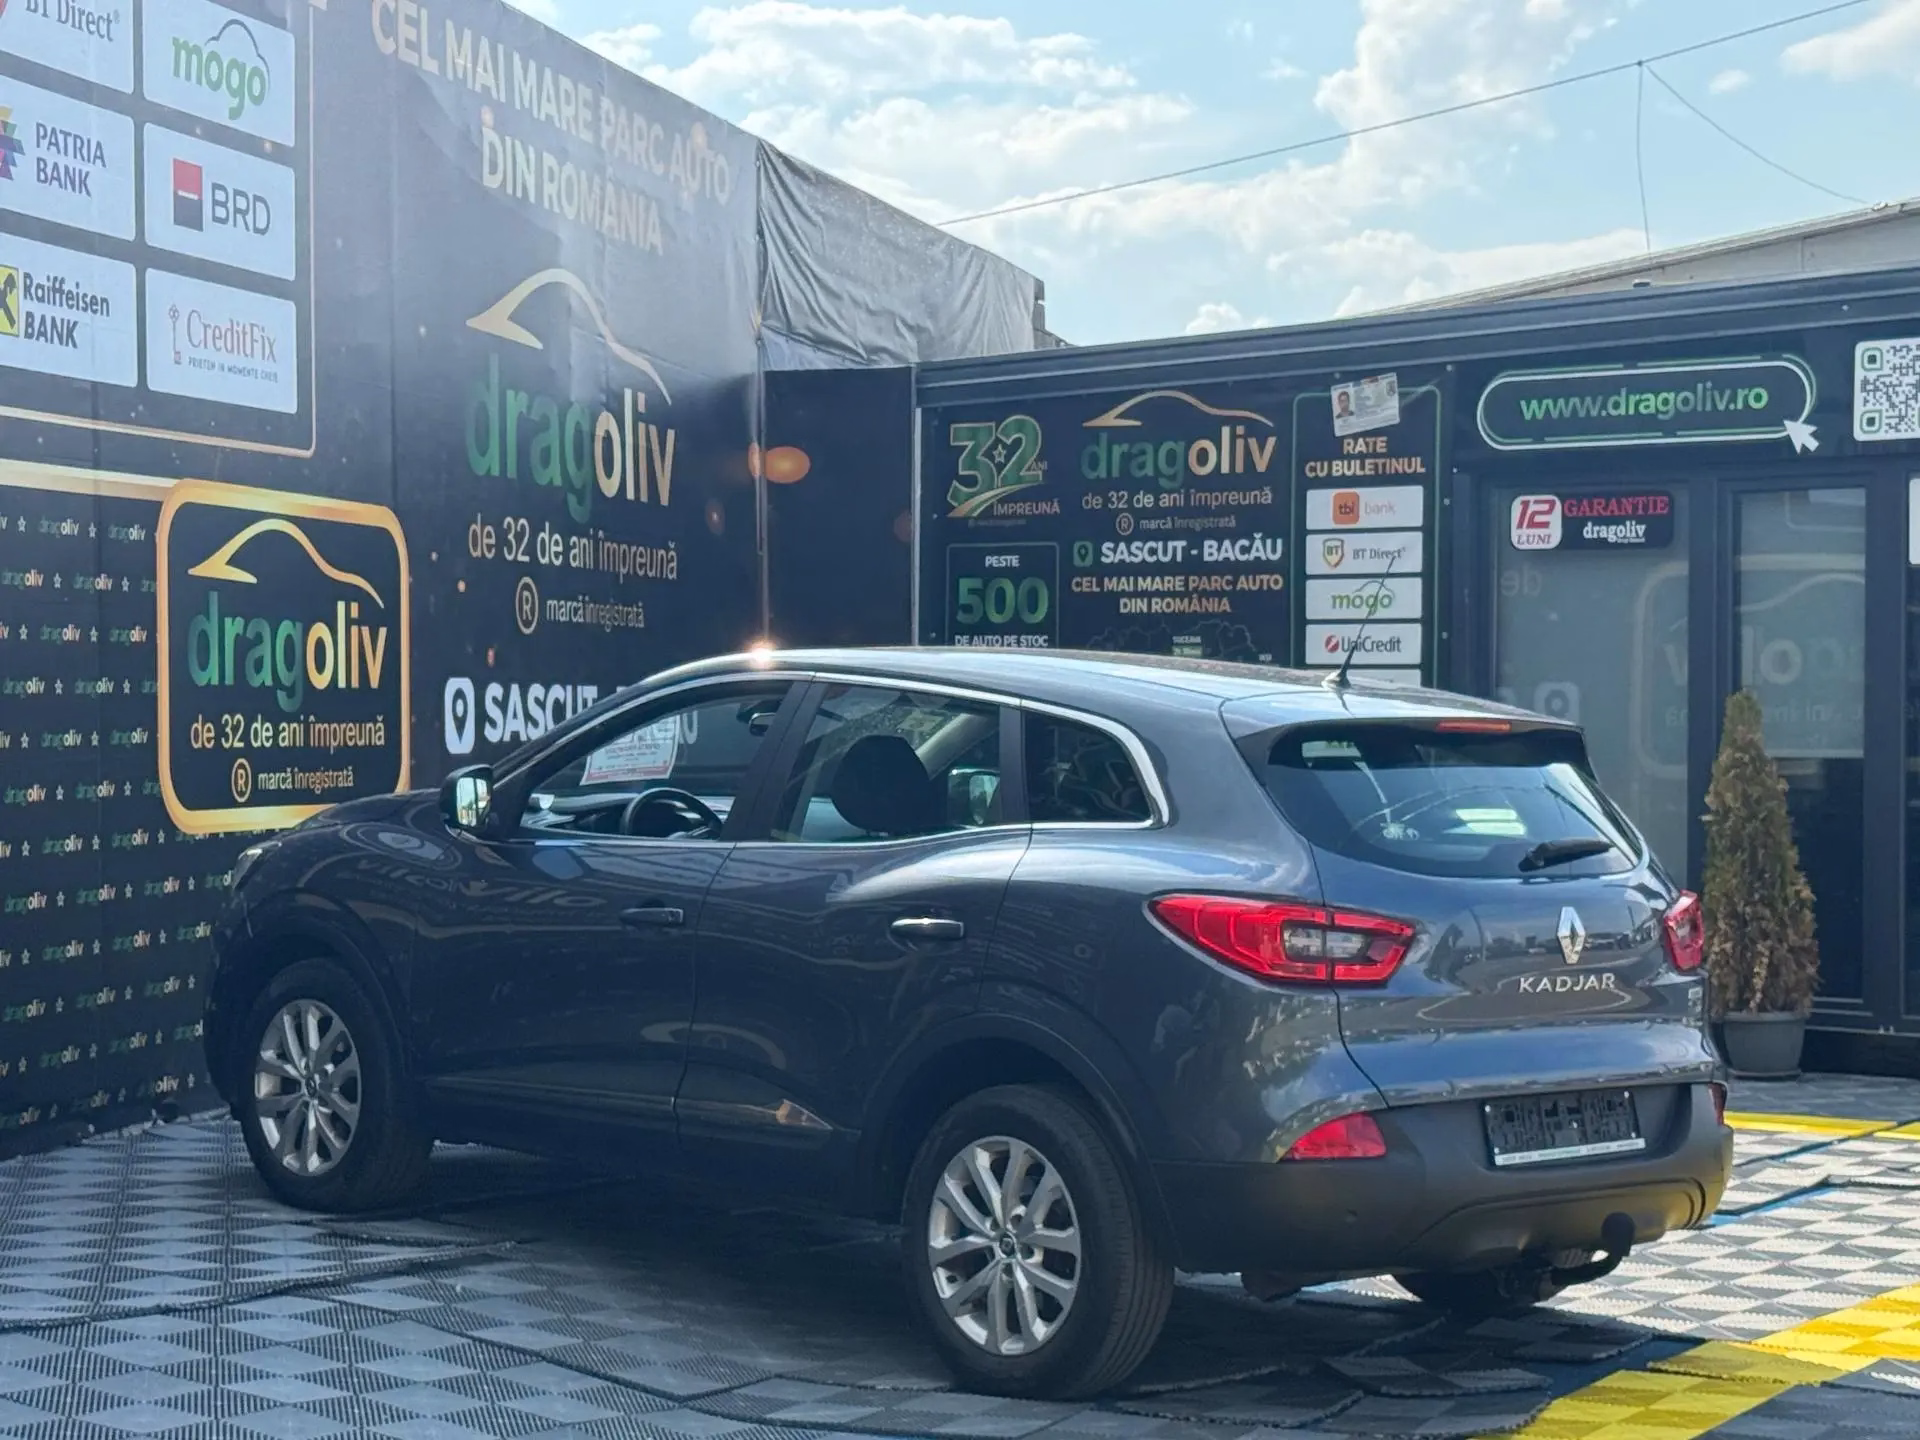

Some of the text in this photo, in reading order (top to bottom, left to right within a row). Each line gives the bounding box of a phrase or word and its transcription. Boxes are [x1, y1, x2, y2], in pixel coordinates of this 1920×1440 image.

[172, 36, 266, 120] mogo
[372, 0, 730, 206] CEL MAI MARE PARC AUTO
[35, 121, 107, 168] PATRIA
[35, 158, 91, 199] BANK
[482, 126, 663, 256] DIN ROMÂNIA
[211, 181, 271, 235] BRD
[23, 272, 110, 318] Raiffeisen
[24, 314, 78, 350] BANK
[187, 309, 276, 363] CreditFix
[1520, 382, 1769, 421] www.dragoliv.ro
[466, 353, 676, 523] dragoliv
[1343, 436, 1388, 455] RATE
[947, 415, 1042, 508] 32
[1080, 425, 1276, 490] dragoliv
[1305, 457, 1426, 478] CU BULETINUL
[1082, 486, 1272, 510] de 32 de ani împreună
[1338, 501, 1396, 516] tbi bank
[1564, 495, 1670, 517] GARANTIE
[1516, 498, 1557, 530] 12
[1516, 534, 1552, 546] LUNI
[1583, 520, 1647, 542] dragoliv
[469, 514, 678, 581] de 32 de ani împreună
[985, 555, 1019, 568] PESTE
[1101, 540, 1187, 563] SASCUT
[1203, 532, 1283, 562] BACĂU
[1327, 545, 1340, 556] BT
[1353, 549, 1366, 560] BT
[1071, 574, 1283, 593] CEL MAI MARE PARC AUTO
[546, 594, 584, 623] marcă
[957, 577, 1048, 625] 500
[1119, 594, 1230, 614] DIN ROMÂNIA
[1331, 593, 1393, 616] mogo
[187, 590, 387, 713] dragoliv
[955, 634, 1049, 648] DE AUTO PE STOC
[1341, 635, 1402, 653] UniCredit
[190, 714, 386, 755] de 32 de ani împreună
[258, 766, 292, 790] marcă
[1520, 972, 1615, 994] KADJAR
